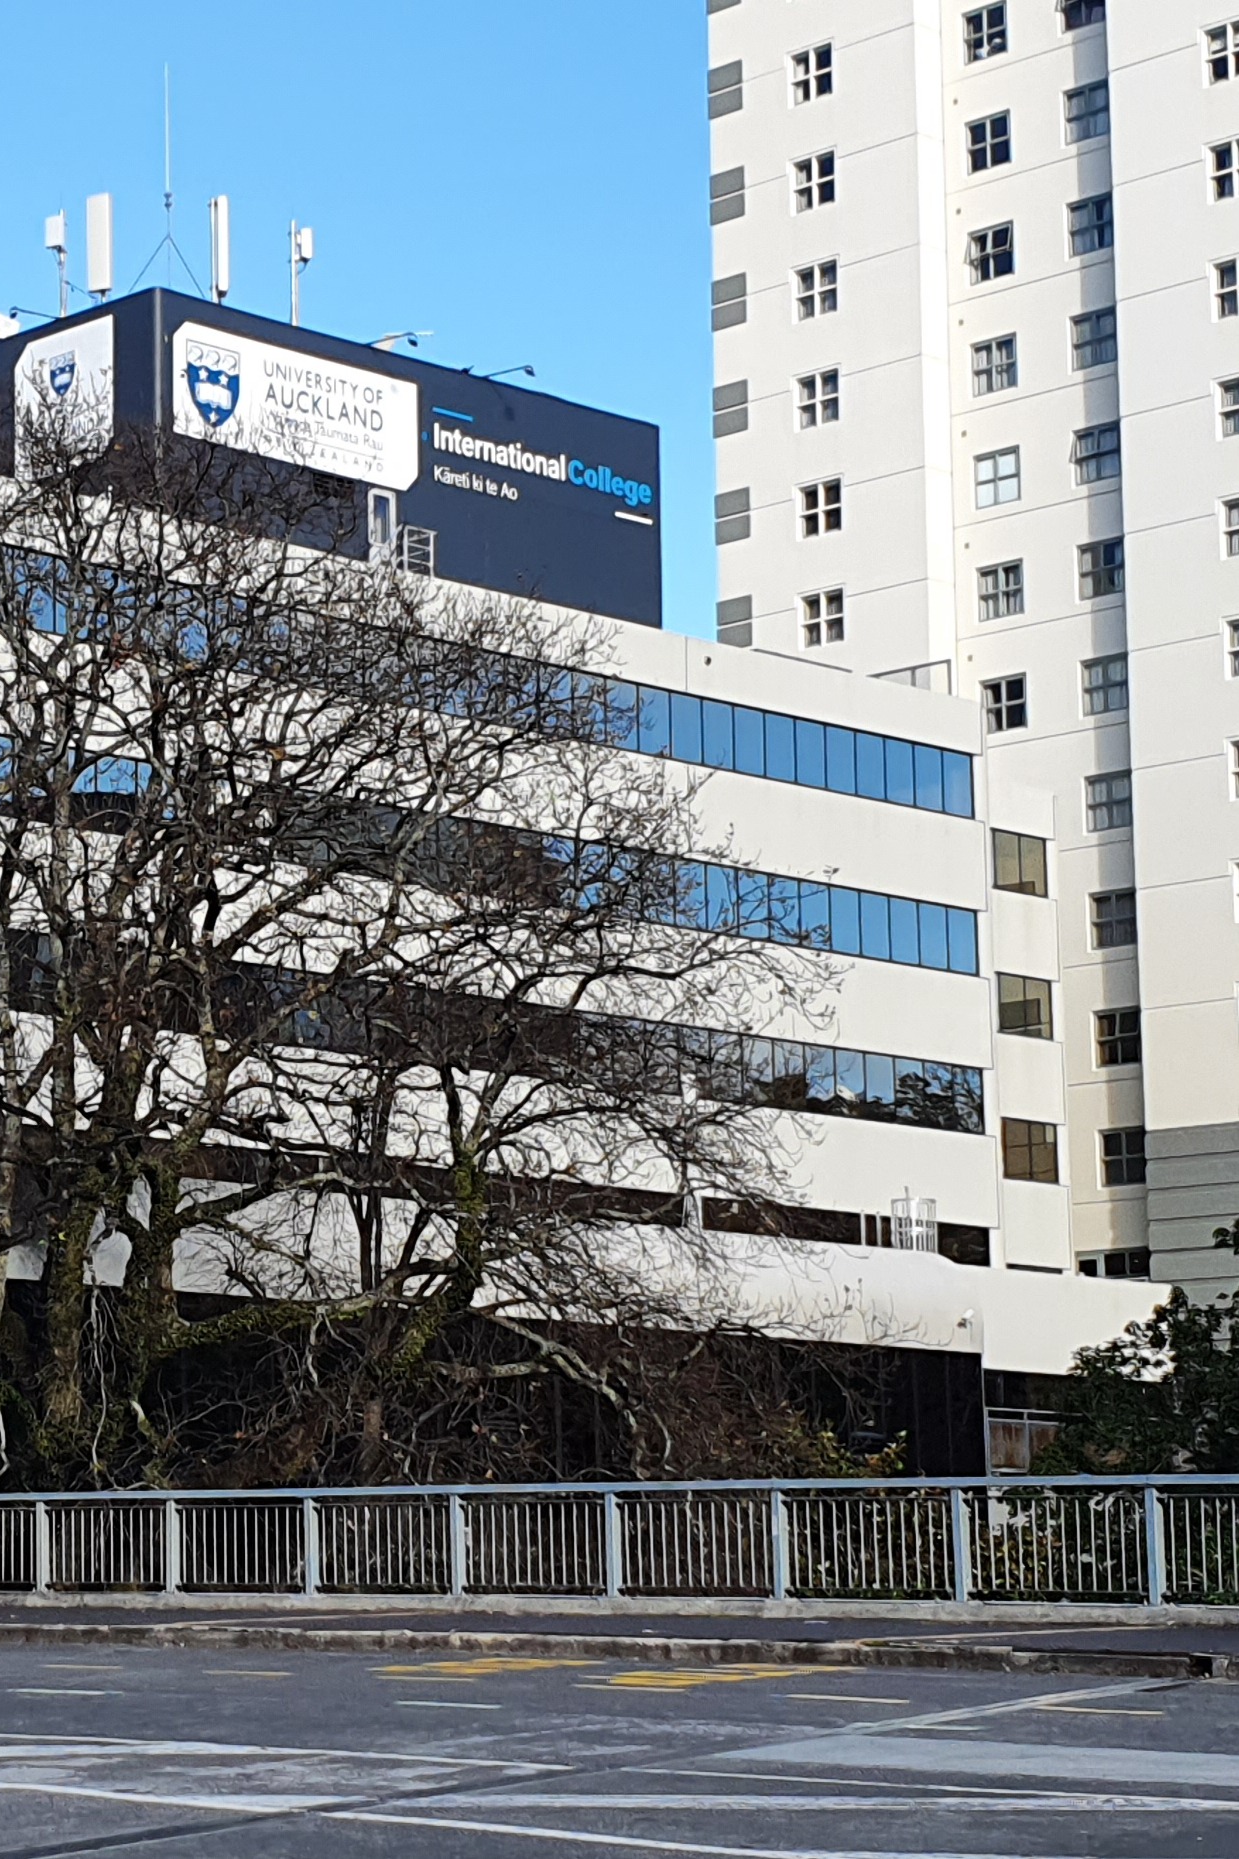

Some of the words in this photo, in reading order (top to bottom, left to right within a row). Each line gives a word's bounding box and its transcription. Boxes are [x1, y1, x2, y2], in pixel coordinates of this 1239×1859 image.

[263, 359, 359, 399] UNIVERSITY
[363, 387, 384, 405] OF
[264, 382, 384, 432] AUCKLAND
[433, 422, 566, 482] International
[568, 459, 653, 507] College
[472, 473, 483, 494] ki
[485, 479, 498, 496] te
[500, 482, 519, 501] Ao
